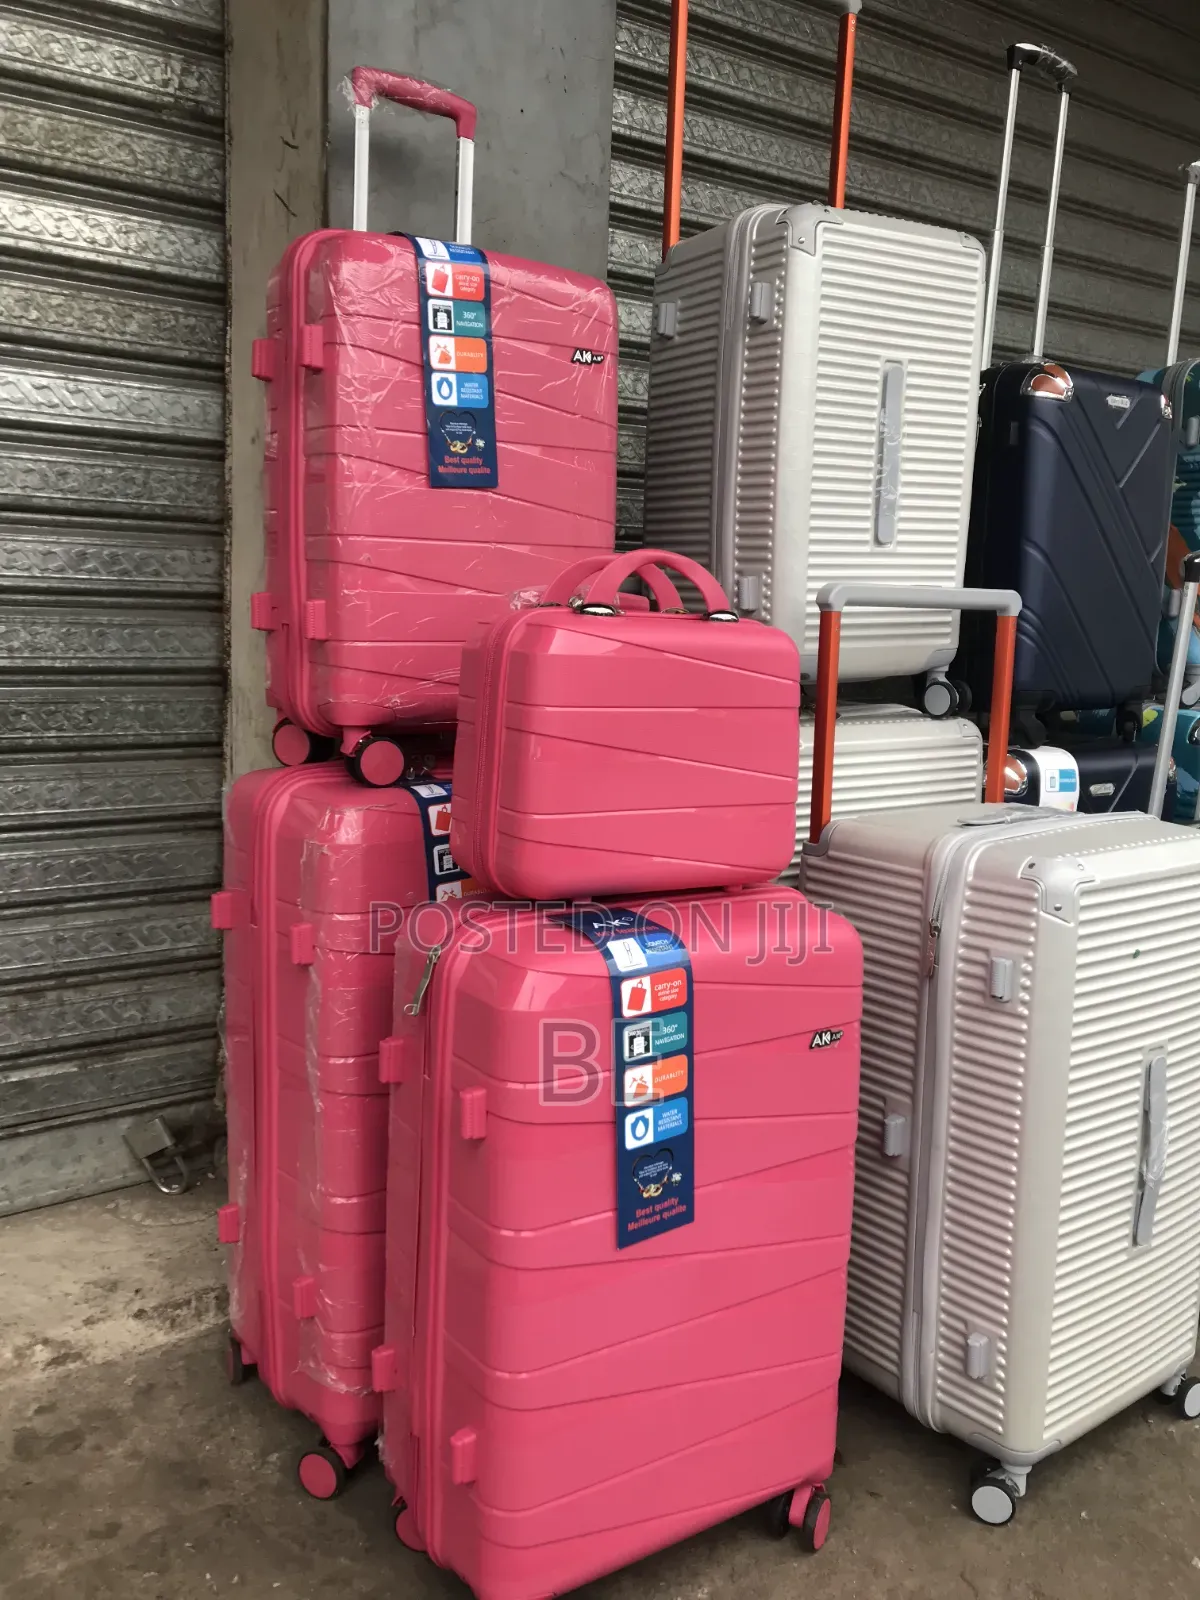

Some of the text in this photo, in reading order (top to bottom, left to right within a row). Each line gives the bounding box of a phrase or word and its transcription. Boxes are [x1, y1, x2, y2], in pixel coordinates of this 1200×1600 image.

[444, 455, 483, 466] Best quality
[654, 979, 682, 991] carry-on
[654, 1033, 685, 1046] NAVIGATION
[658, 1113, 682, 1125] RESISTANT
[661, 1109, 678, 1118] WATER
[657, 1120, 683, 1132] MATERIALS
[635, 1197, 679, 1218] Best quality
